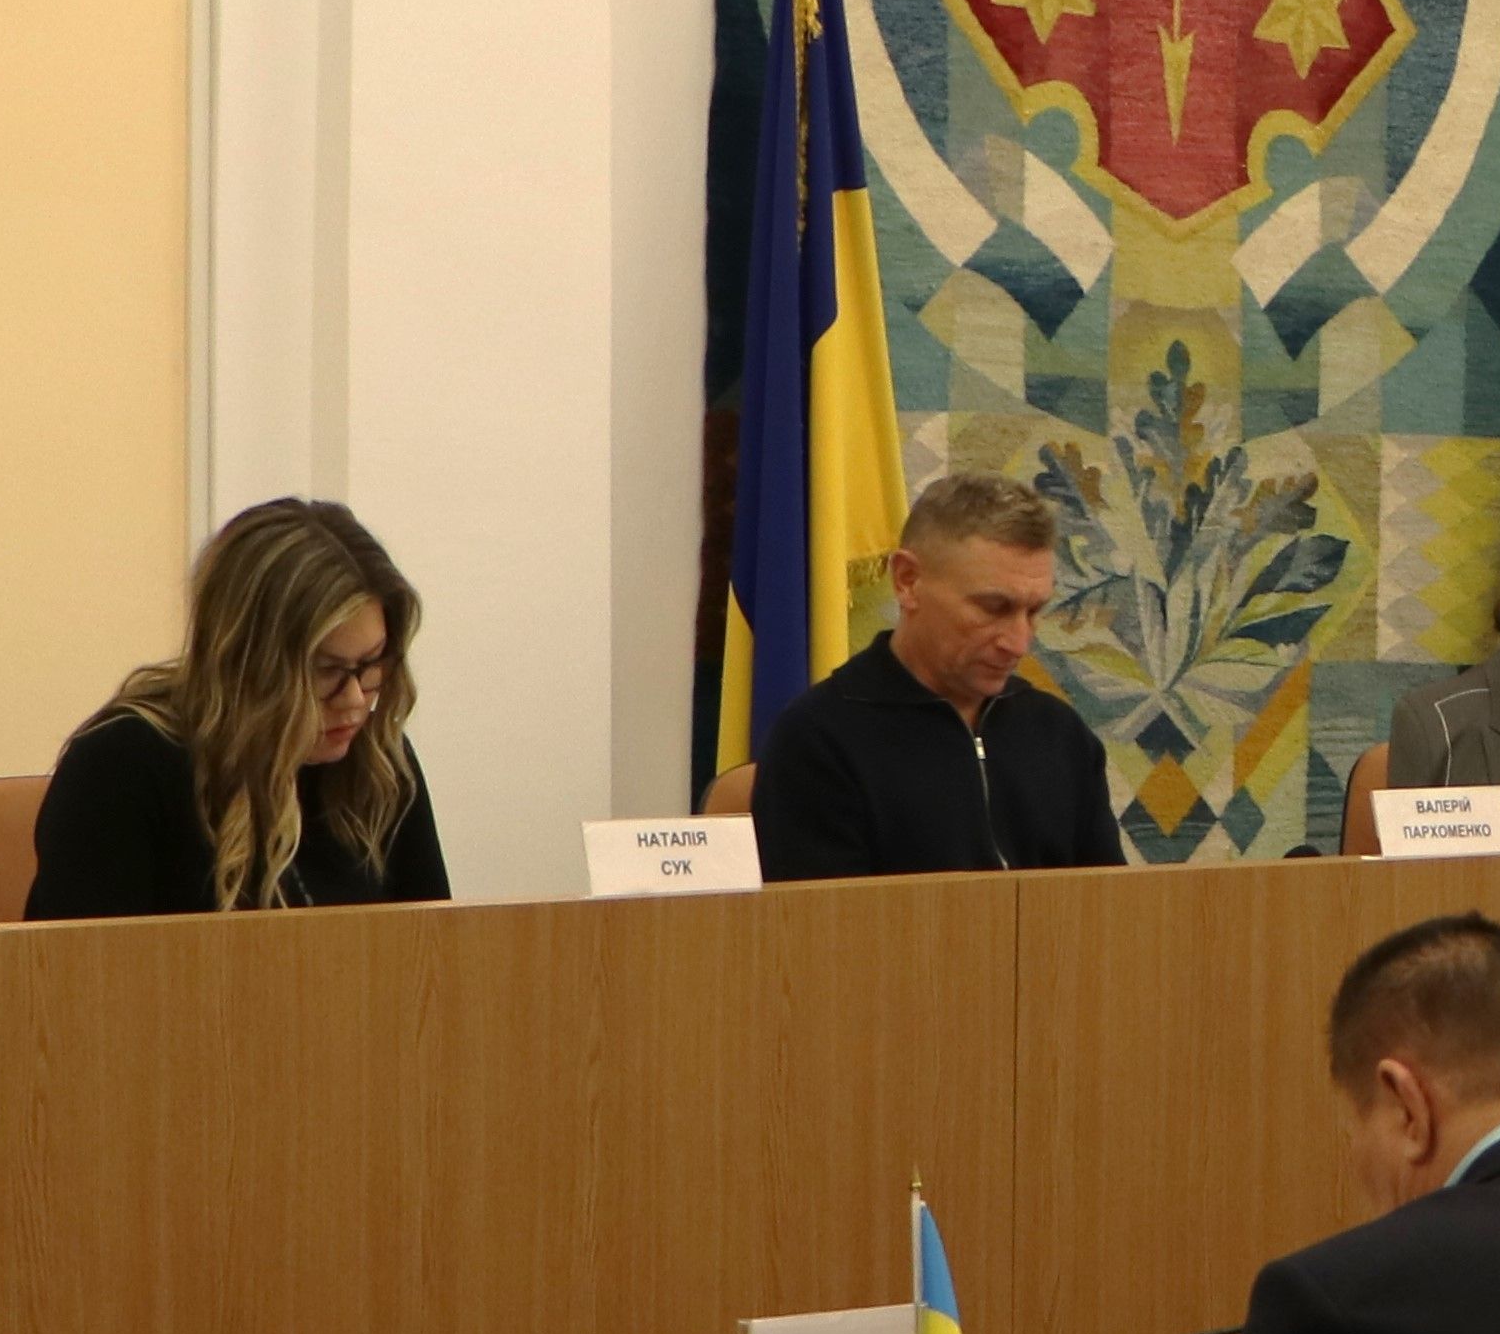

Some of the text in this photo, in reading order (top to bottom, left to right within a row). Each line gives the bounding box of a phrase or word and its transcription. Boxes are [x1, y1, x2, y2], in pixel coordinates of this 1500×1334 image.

[1415, 797, 1472, 814] ВАЛЕРІЙ
[636, 831, 708, 848] НАТАЛІЯ
[1403, 823, 1492, 840] ПАРХОМЕНКО
[661, 859, 693, 876] СУК
